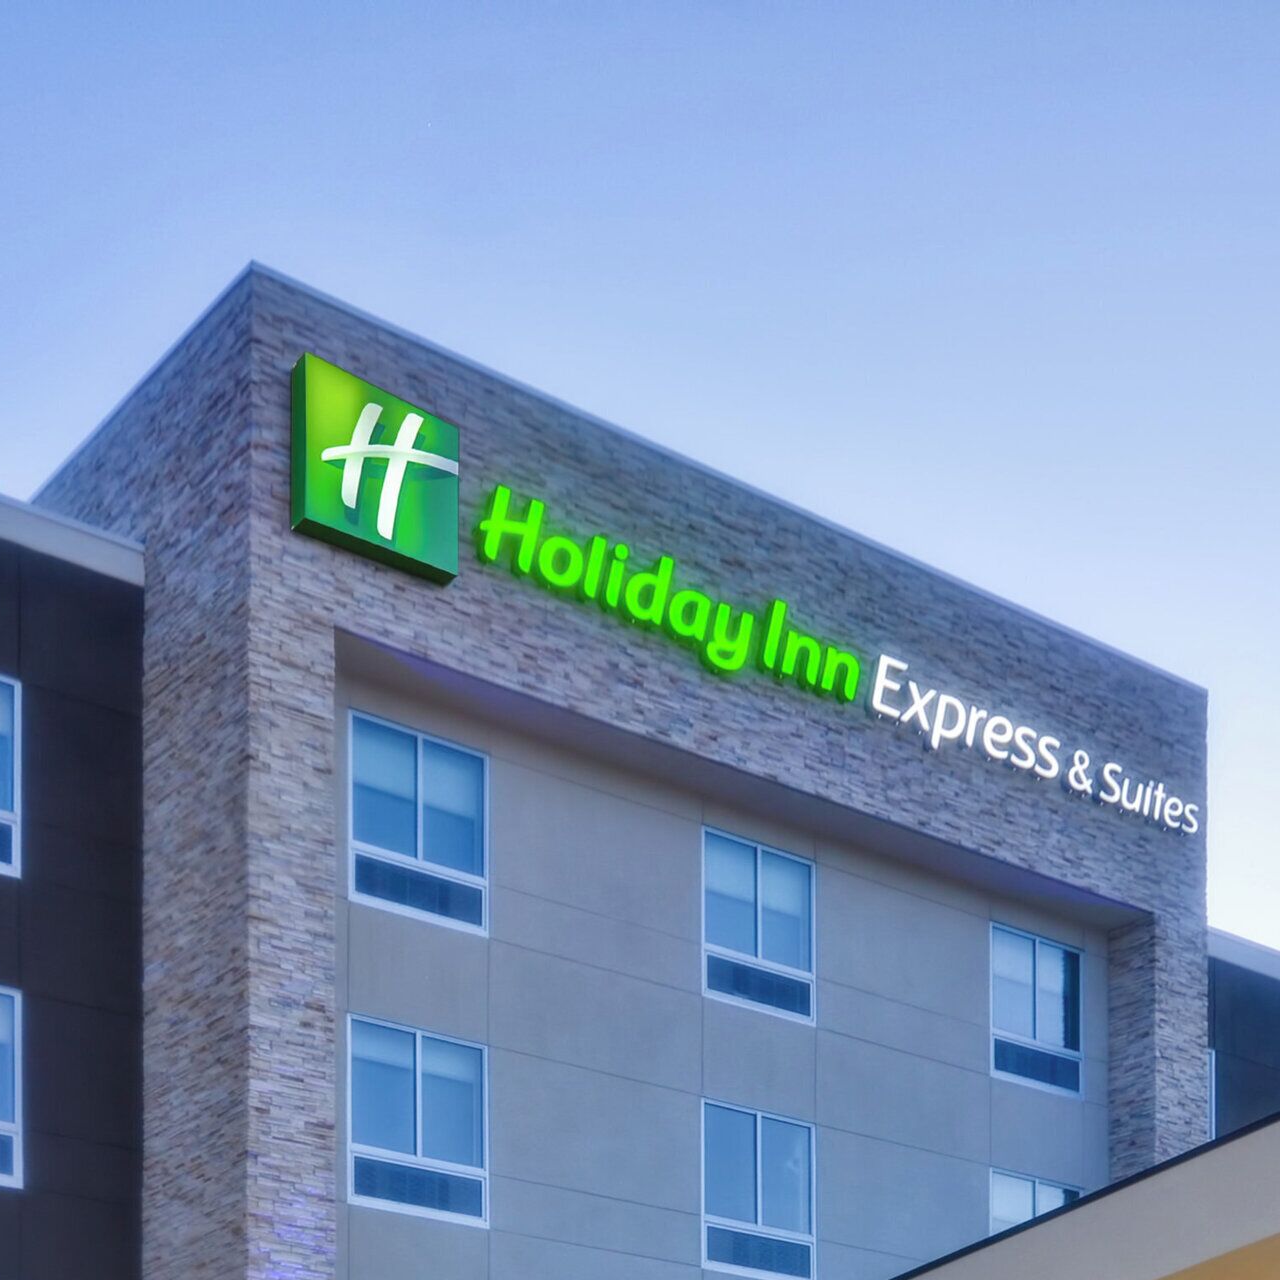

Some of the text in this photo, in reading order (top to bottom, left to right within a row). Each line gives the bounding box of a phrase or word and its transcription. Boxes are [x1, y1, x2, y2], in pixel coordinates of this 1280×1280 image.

[479, 484, 1199, 834] Holiday Inn Express & Suites
